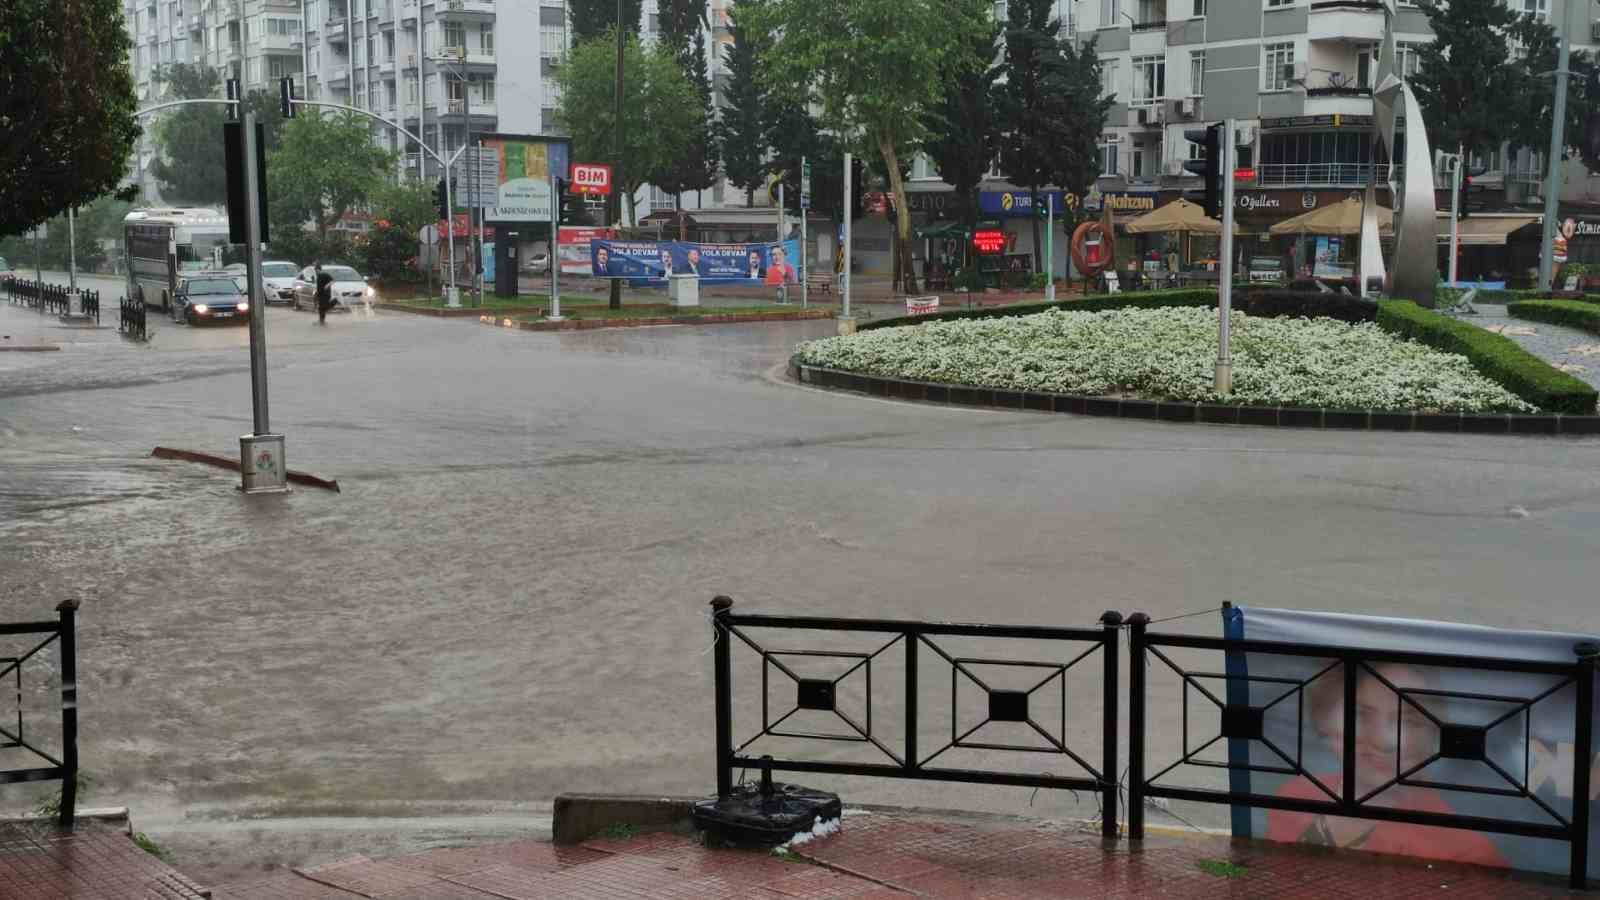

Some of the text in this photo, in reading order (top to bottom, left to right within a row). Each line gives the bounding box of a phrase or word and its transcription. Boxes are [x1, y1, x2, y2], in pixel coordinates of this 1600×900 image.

[632, 248, 658, 256] DEVAM
[701, 249, 747, 257] YOLA DEVAM
